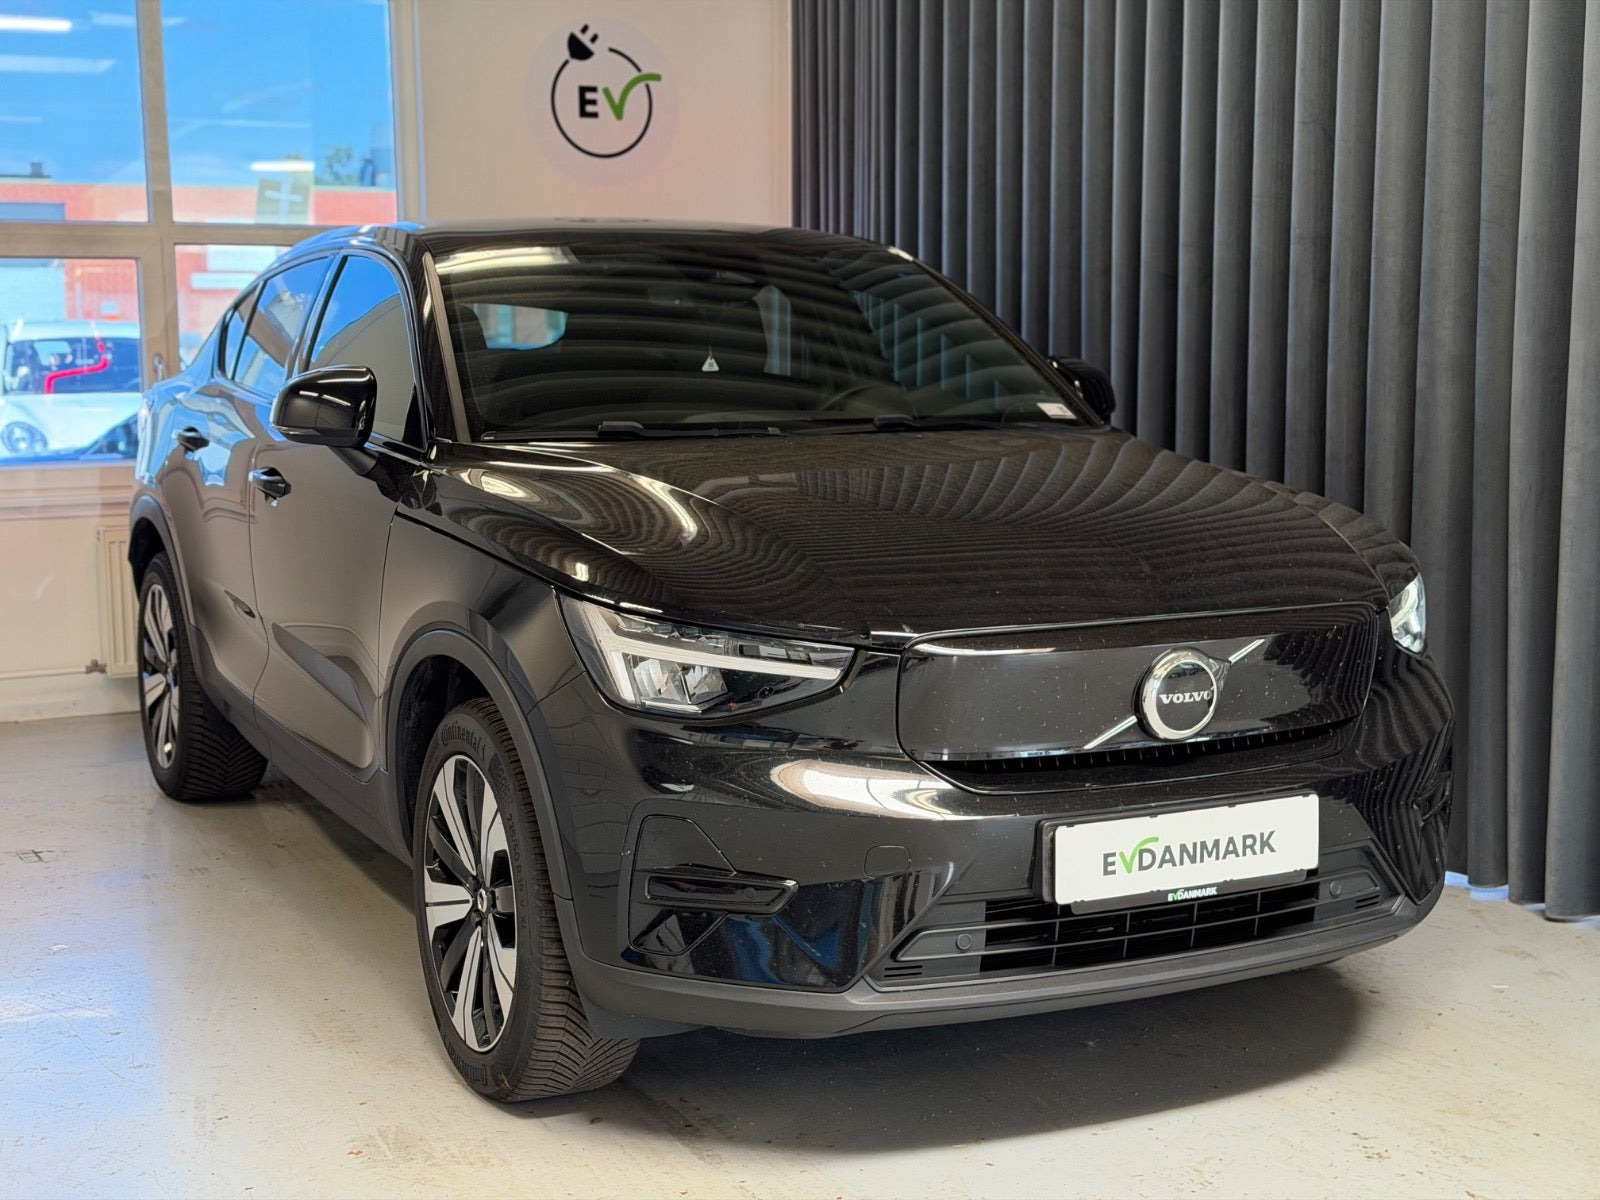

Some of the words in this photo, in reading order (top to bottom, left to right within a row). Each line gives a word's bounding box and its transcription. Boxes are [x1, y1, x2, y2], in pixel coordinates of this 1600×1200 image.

[578, 73, 662, 121] EV
[1159, 690, 1213, 704] VOLVO
[440, 720, 482, 756] Continental
[1102, 830, 1277, 877] EVDANMARK
